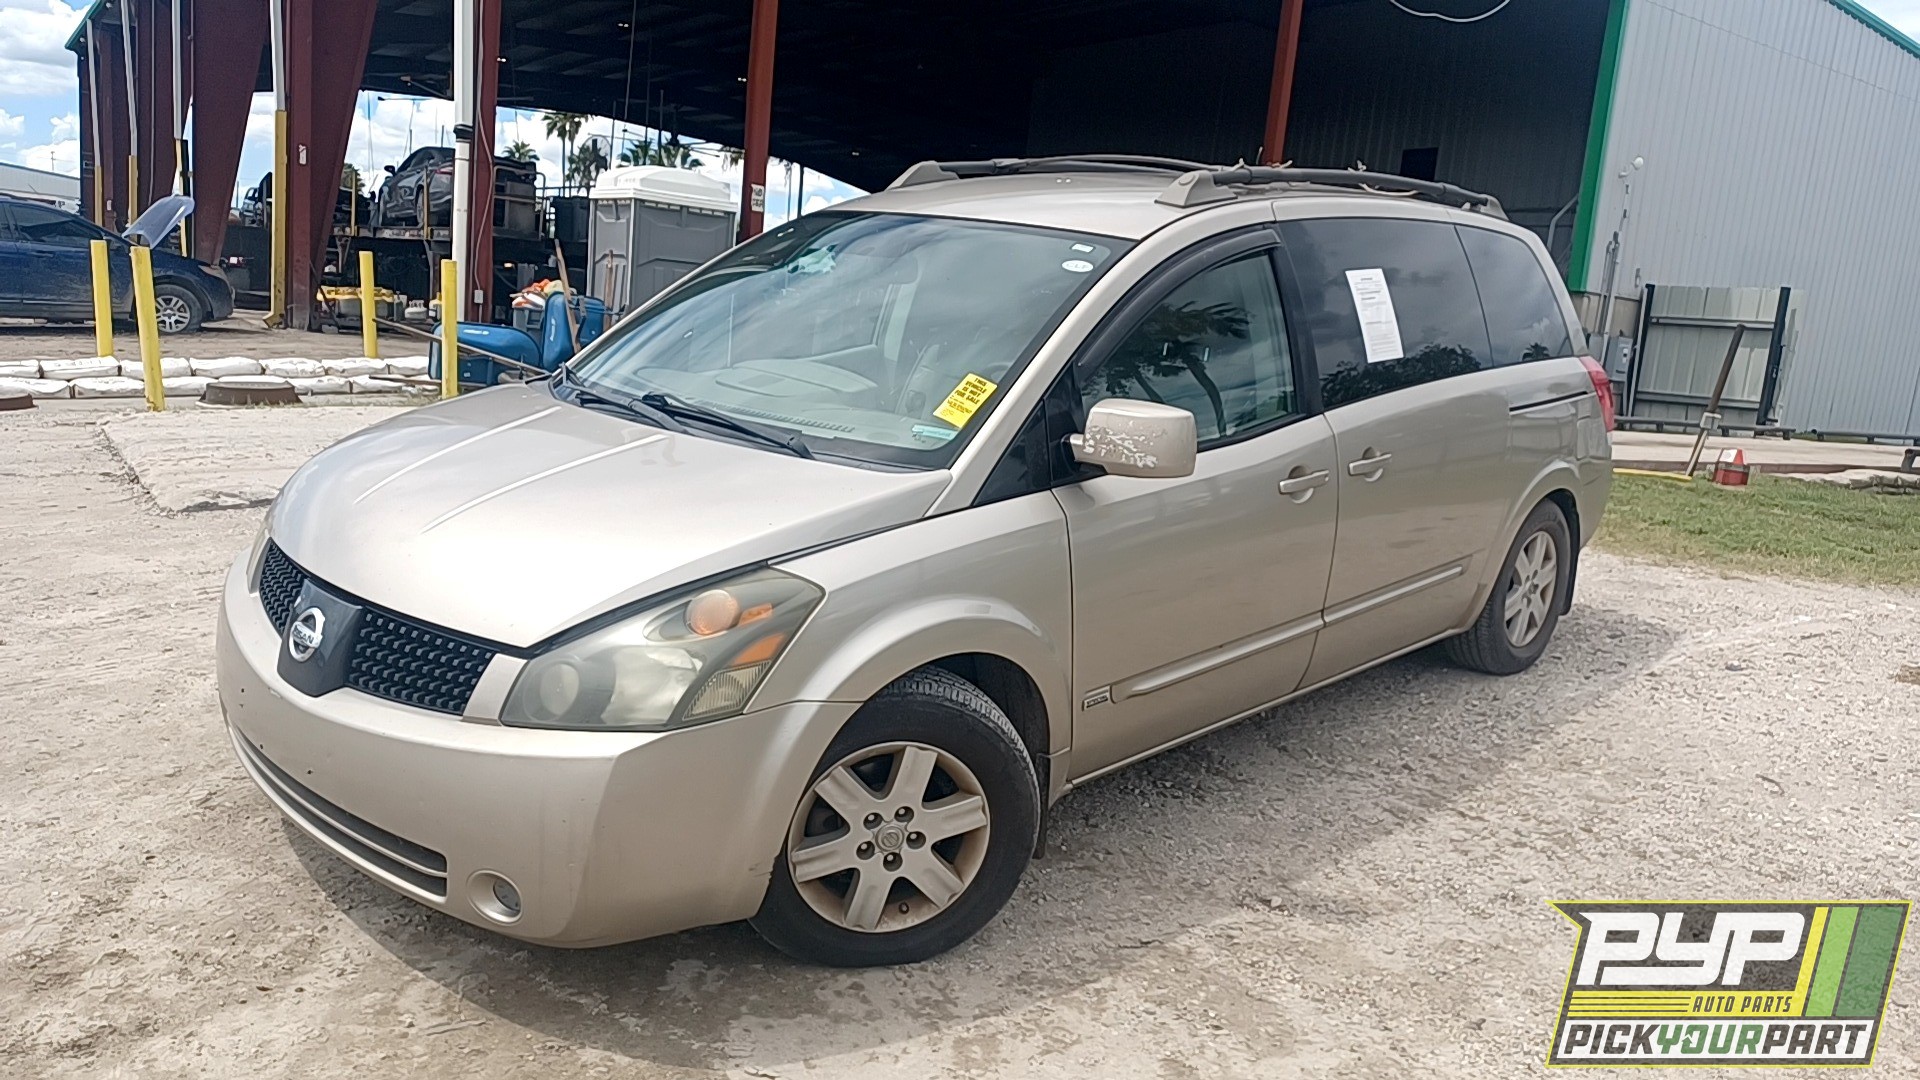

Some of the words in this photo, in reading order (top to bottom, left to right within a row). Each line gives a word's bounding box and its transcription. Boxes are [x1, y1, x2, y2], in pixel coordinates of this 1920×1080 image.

[965, 381, 987, 394] VEHICLE
[974, 378, 987, 387] THIS
[954, 389, 966, 398] FOR
[965, 395, 980, 404] SALE
[969, 390, 981, 398] NOT
